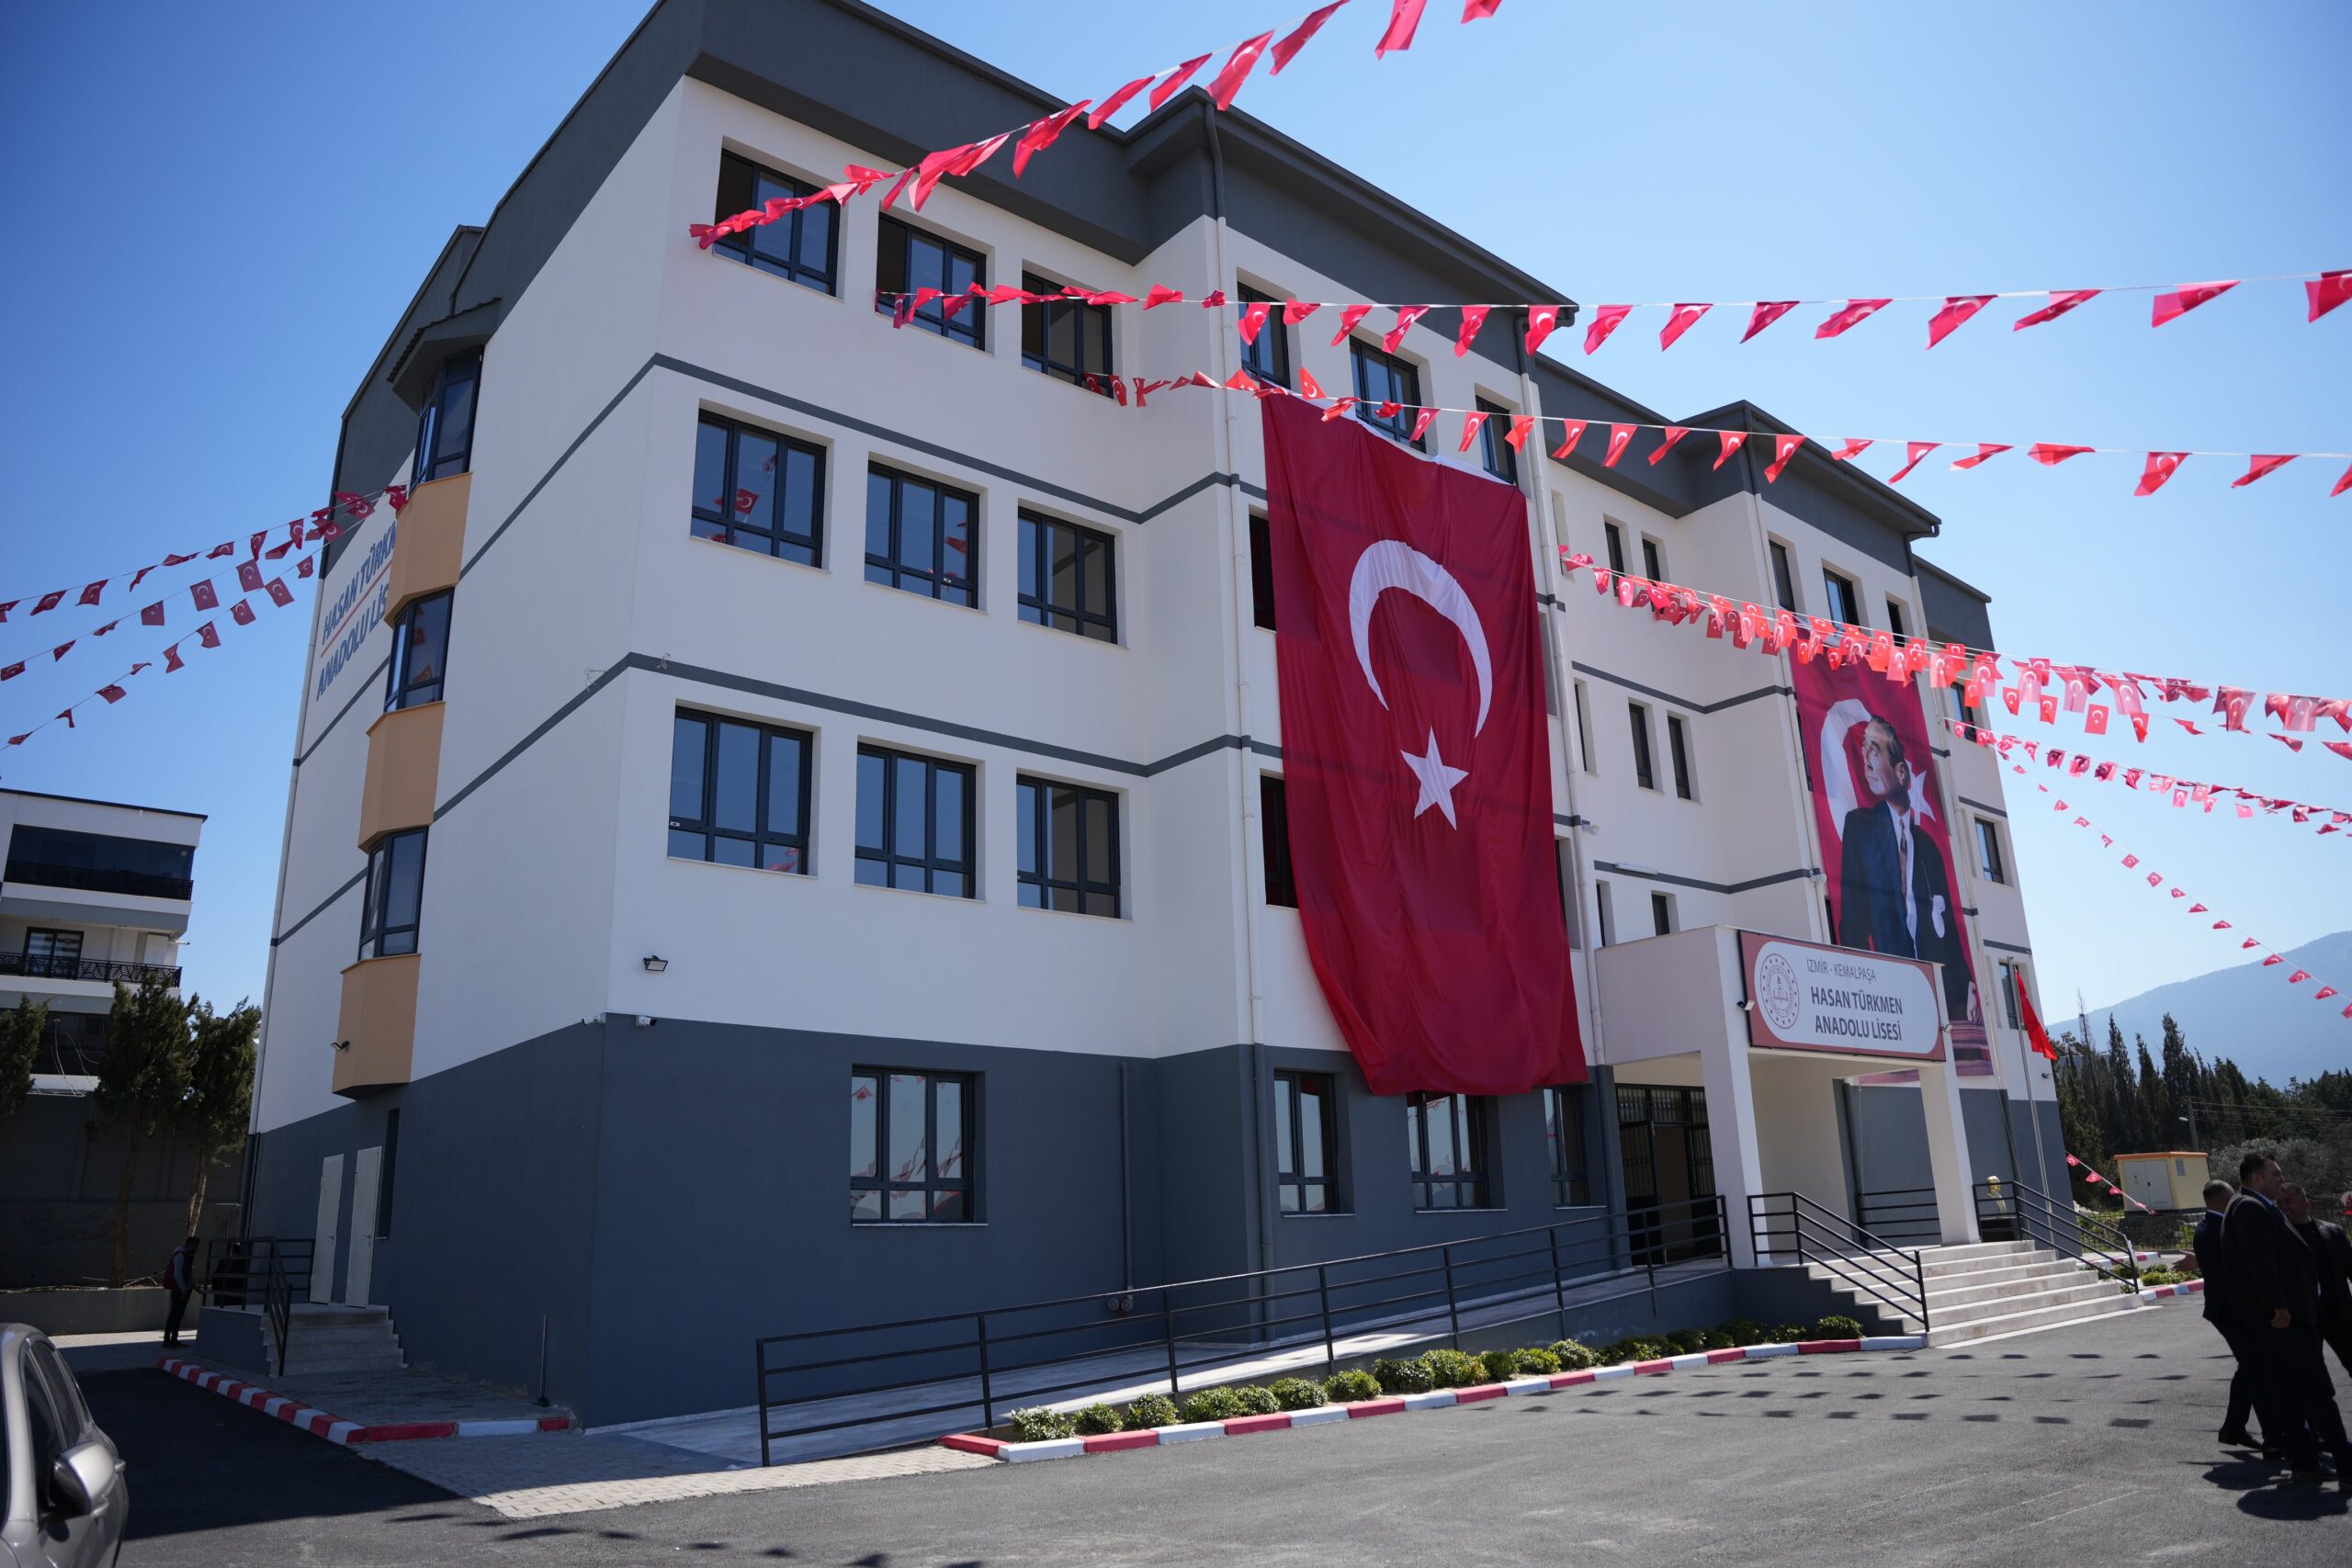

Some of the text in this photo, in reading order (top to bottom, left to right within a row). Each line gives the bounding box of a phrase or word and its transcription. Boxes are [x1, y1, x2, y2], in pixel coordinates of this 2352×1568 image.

[322, 571, 359, 646] HASAN
[316, 607, 369, 702] ANADOLU
[1806, 956, 1828, 975] İZMİR
[1834, 963, 1877, 984] KEMALPAŞA
[1810, 986, 1851, 1009] HASAN
[1851, 989, 1904, 1015] TÜRKMEN
[1815, 1015, 1902, 1041] ANADOLU LİSESİ
